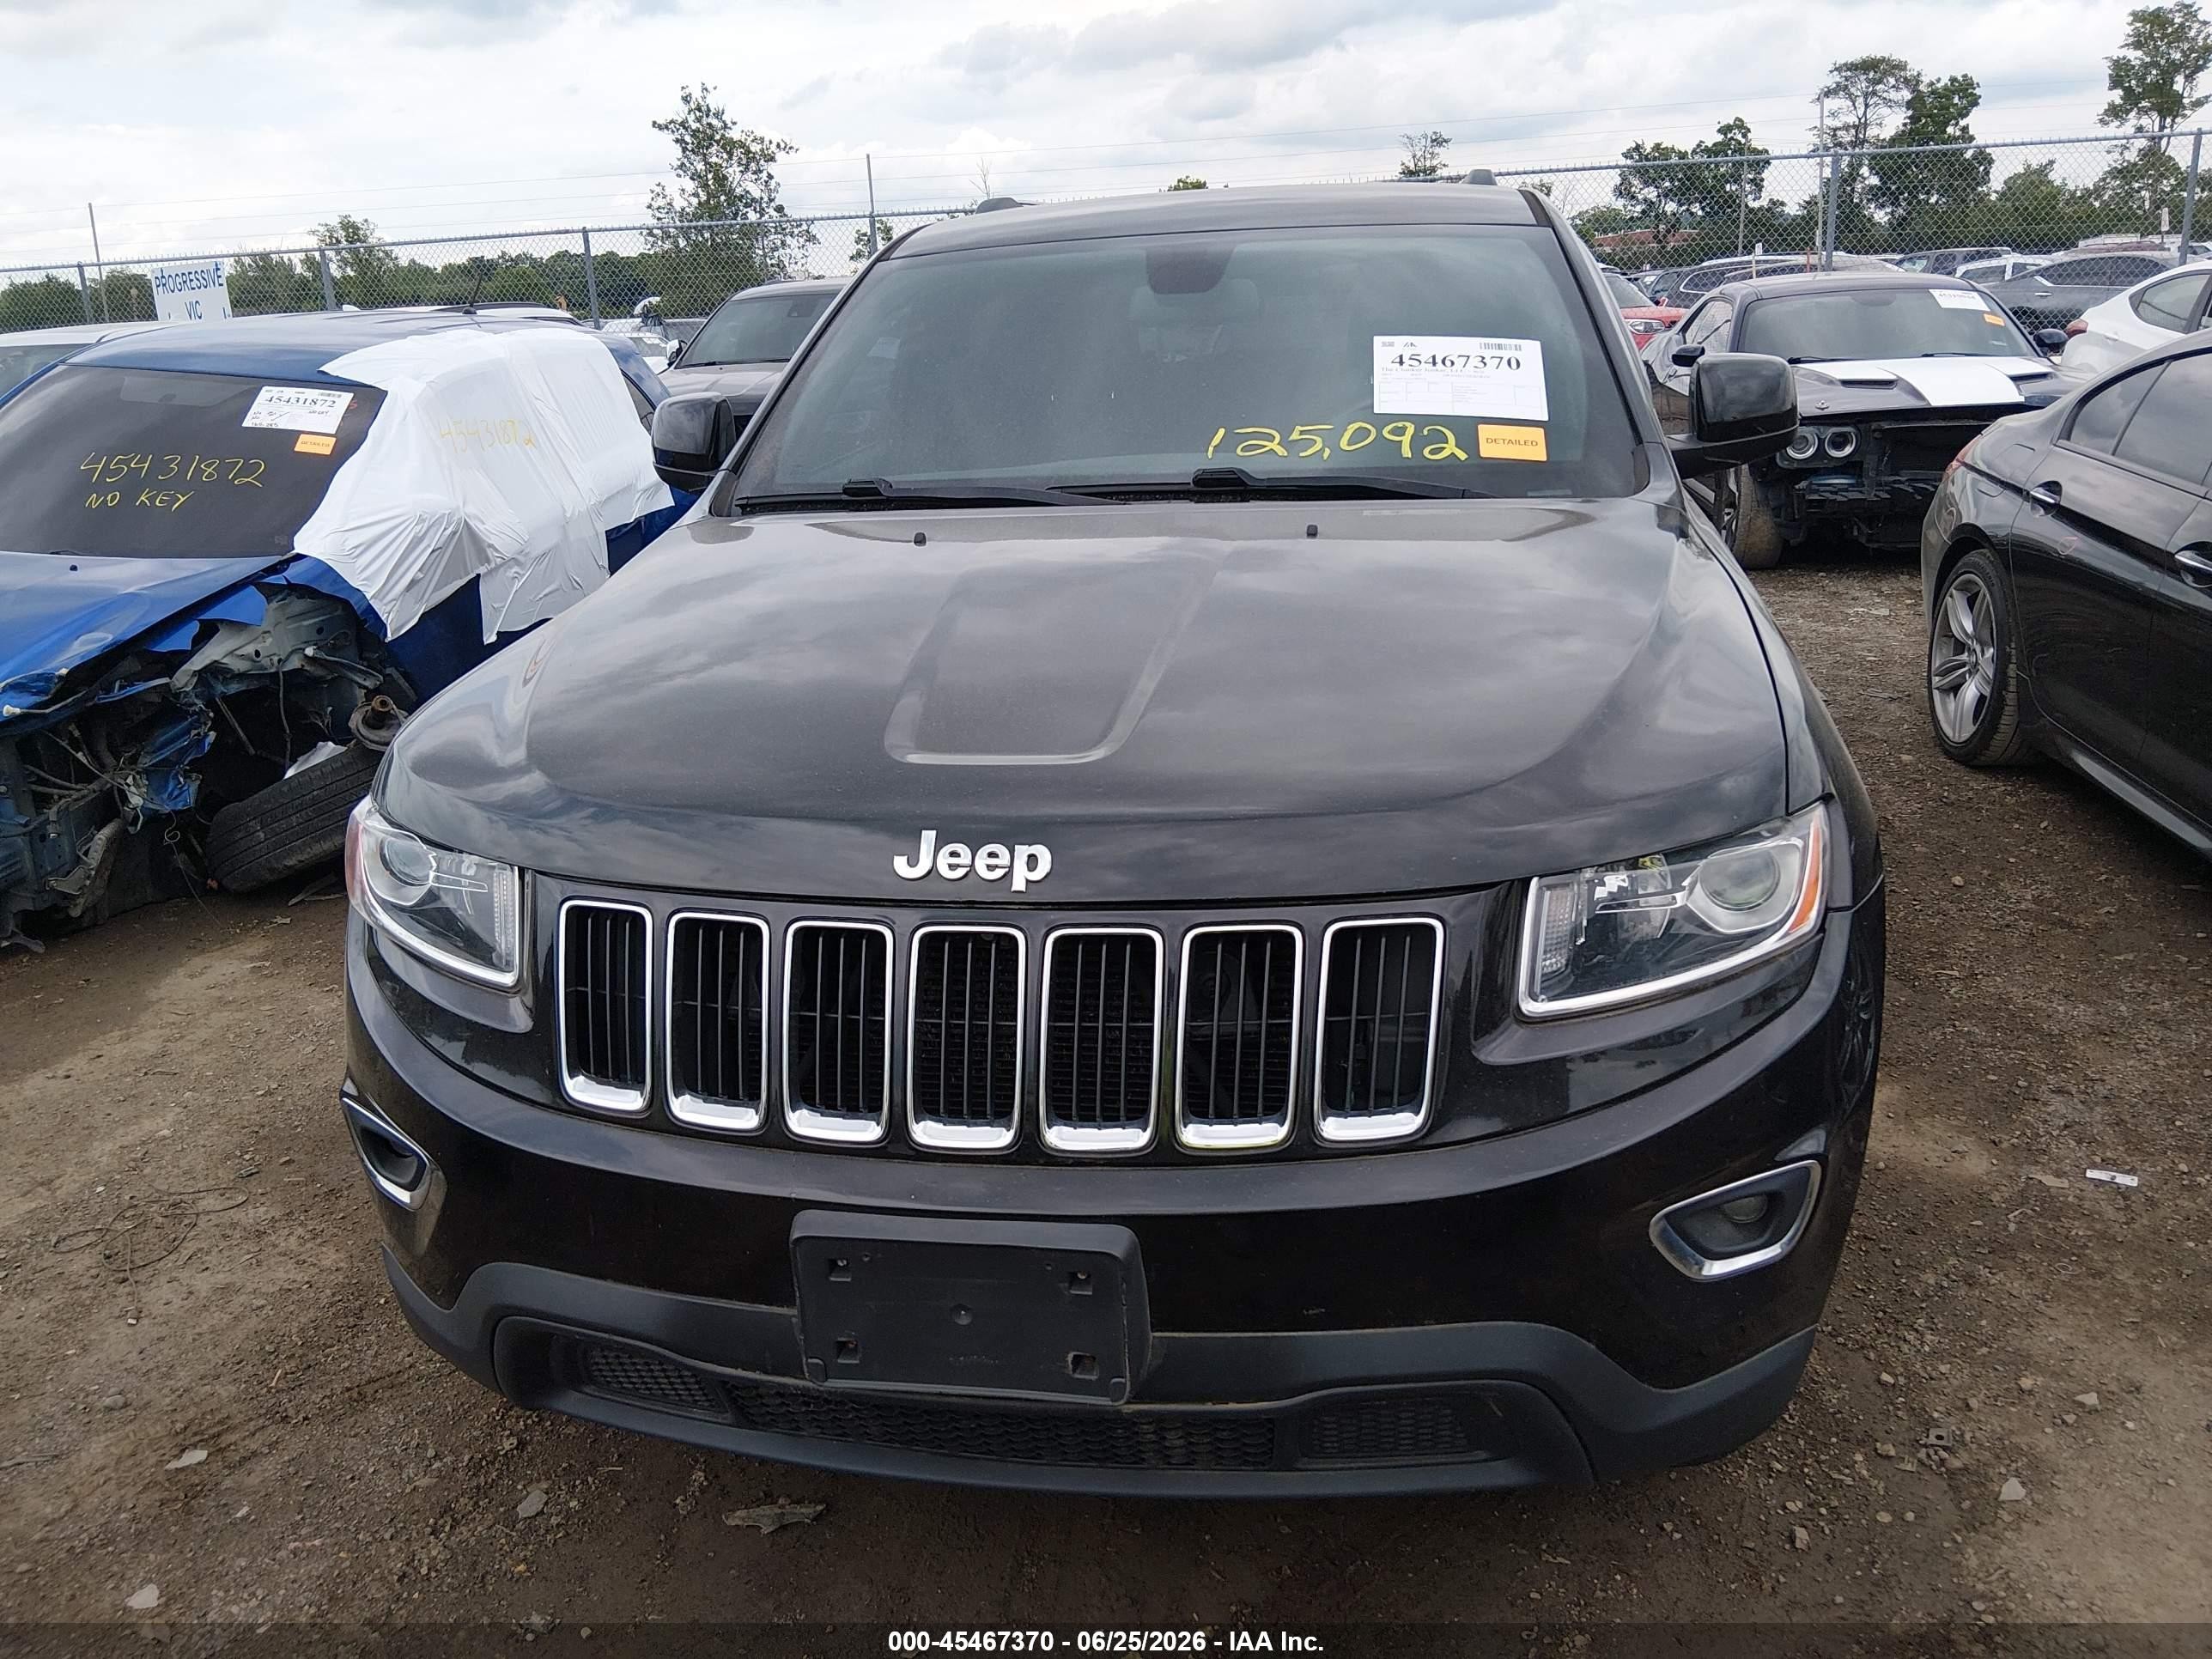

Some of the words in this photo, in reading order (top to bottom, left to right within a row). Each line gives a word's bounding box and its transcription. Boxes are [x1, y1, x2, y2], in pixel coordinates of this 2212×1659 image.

[154, 267, 224, 295] PROGRESSIVE
[185, 301, 203, 320] VIC
[1390, 354, 1522, 371] 45467370
[264, 395, 337, 408] 45431872
[1207, 422, 1469, 461] 125,092
[1486, 436, 1539, 447] DETAILED
[81, 452, 265, 488] 45431872
[85, 490, 120, 509] NO
[136, 488, 195, 512] KEY
[892, 829, 1053, 893] Jeep
